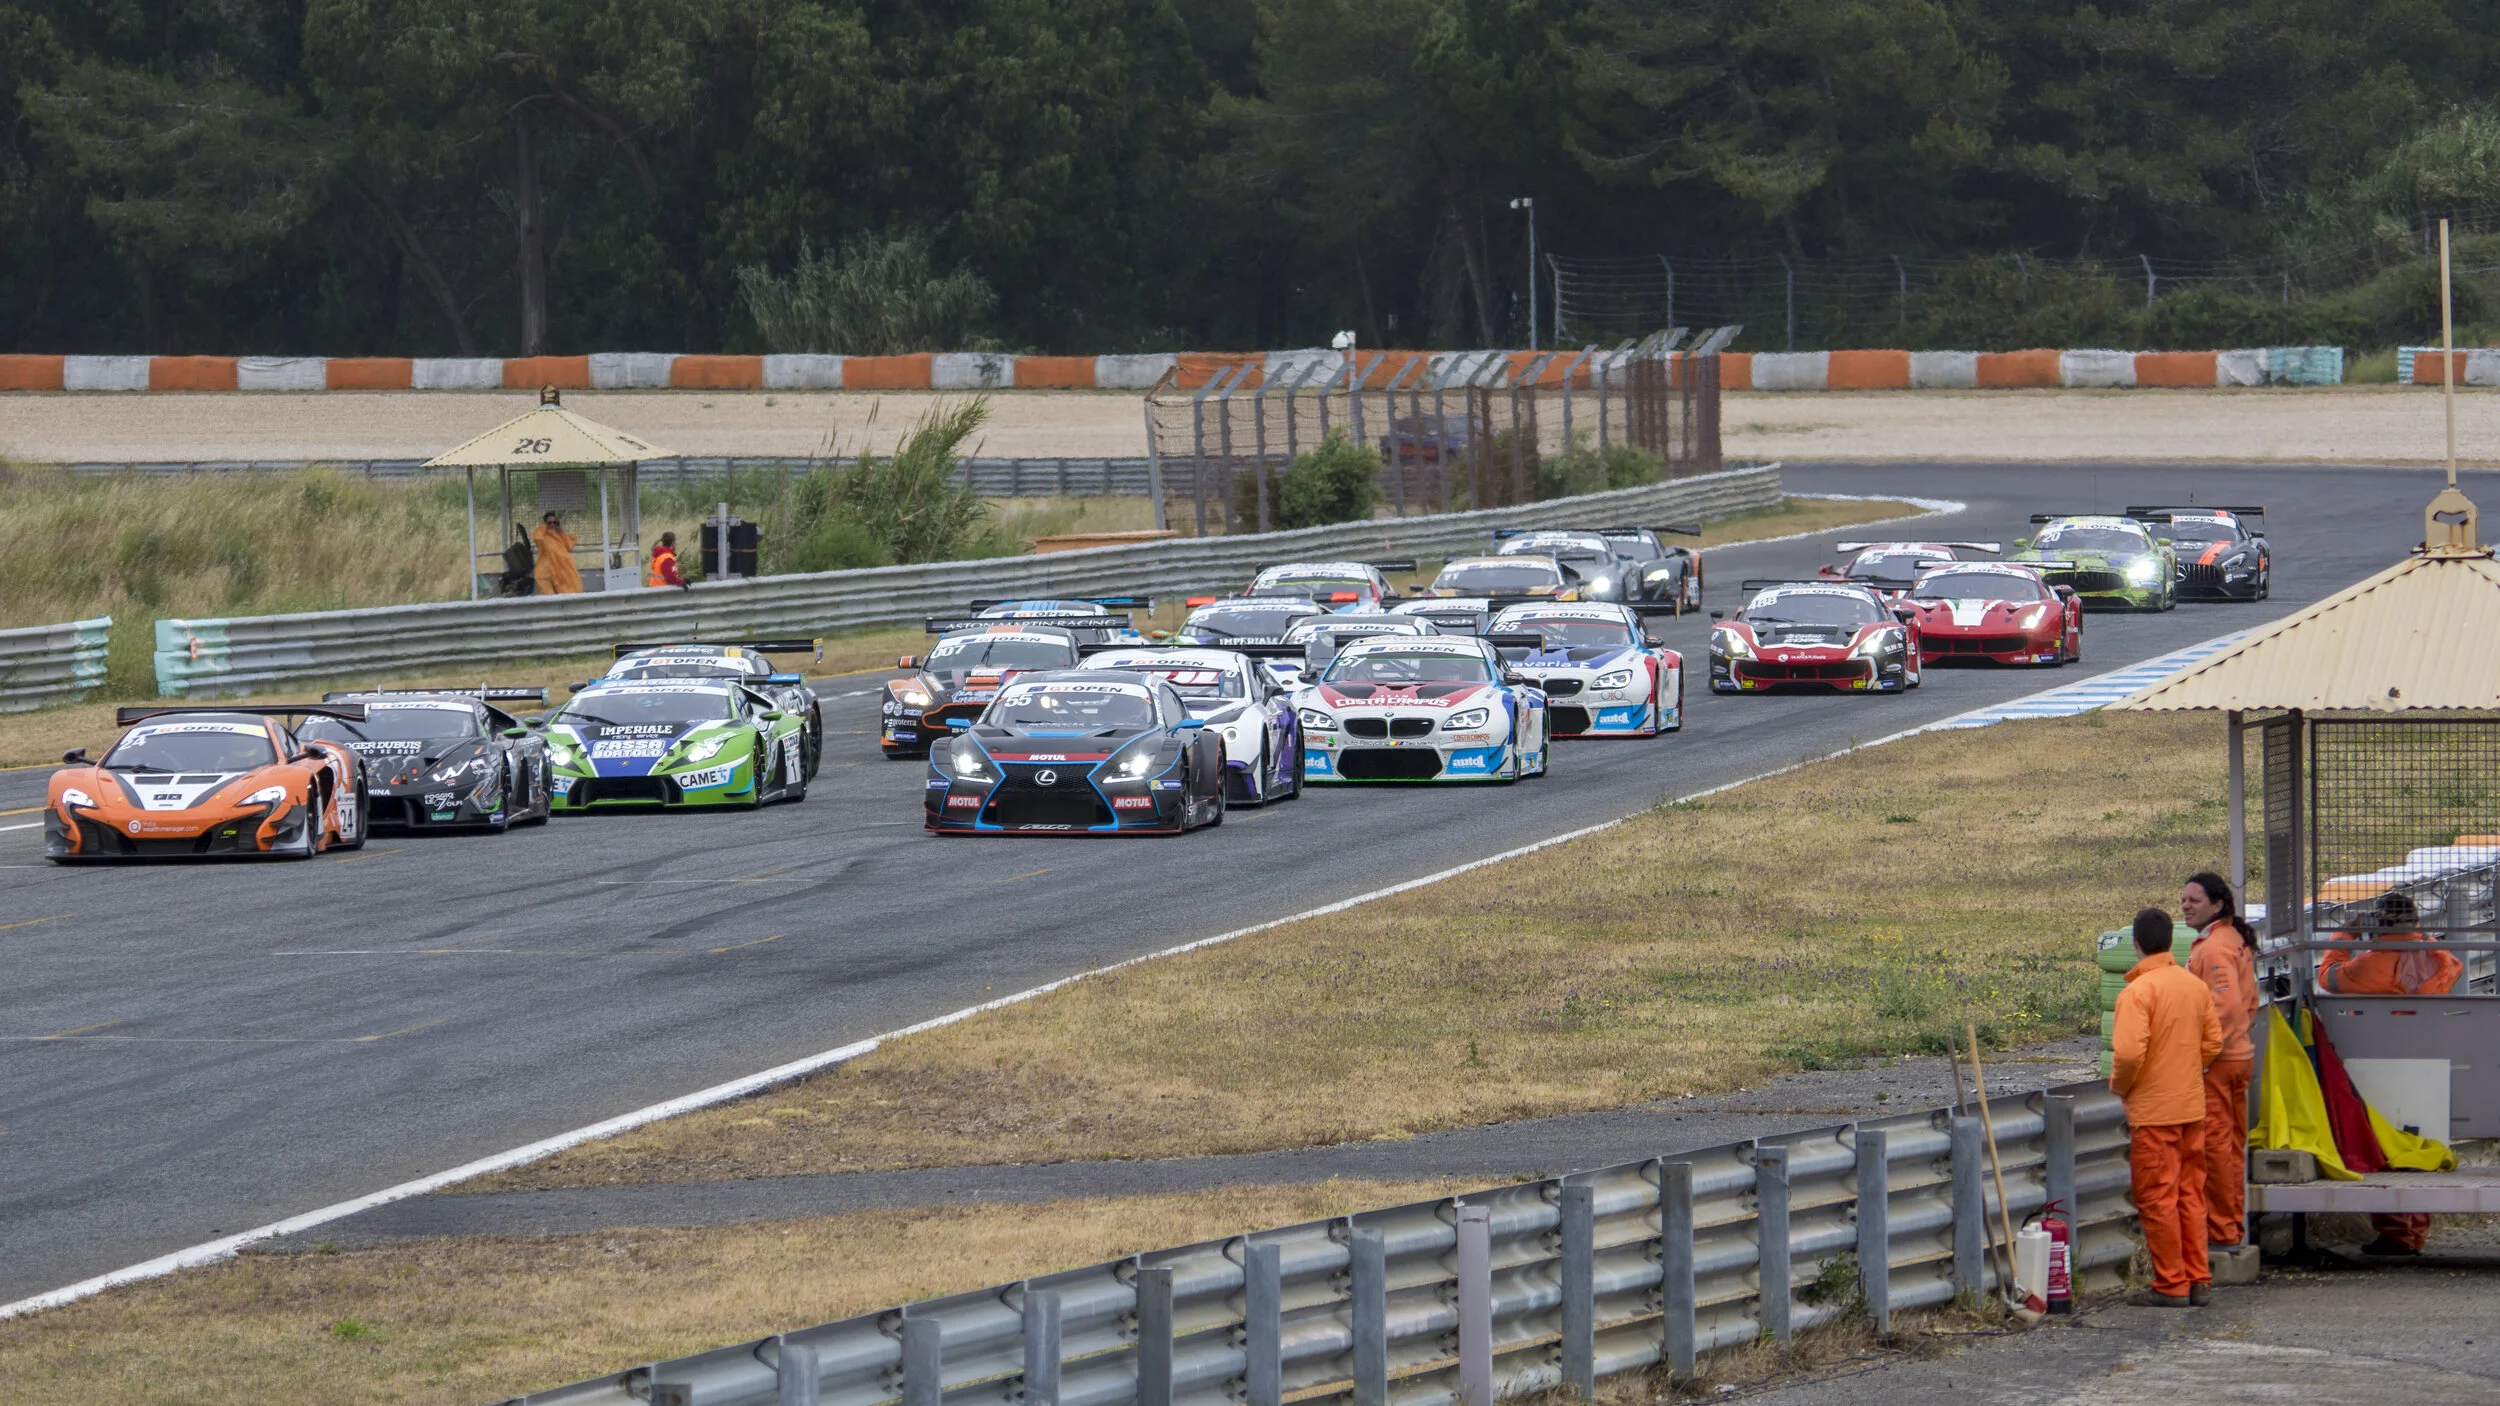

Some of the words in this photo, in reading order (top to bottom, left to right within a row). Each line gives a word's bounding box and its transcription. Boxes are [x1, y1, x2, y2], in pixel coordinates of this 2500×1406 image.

[512, 437, 553, 455] 26
[2043, 532, 2061, 543] 20
[945, 621, 996, 630] ASTON
[1056, 618, 1117, 627] RACING
[1493, 622, 1521, 632] 65
[1293, 633, 1319, 644] 54
[931, 644, 967, 659] 007
[1049, 685, 1123, 693] GTOPEN
[1004, 693, 1033, 708] 55
[1335, 697, 1387, 708] COSTA
[1388, 697, 1452, 708] CAMPOS
[600, 725, 673, 736] IMPERIALE
[120, 735, 147, 750] 24
[343, 741, 377, 750] OGER
[377, 741, 422, 749] DUBUIS
[594, 739, 662, 750] FASSA
[592, 748, 663, 758] BORTOLO
[679, 770, 718, 788] CAME
[367, 788, 392, 796] MINA
[424, 792, 455, 801] POGGIO
[948, 796, 980, 807] MOTUL
[1114, 797, 1151, 808] MOTUL
[340, 808, 354, 833] 24
